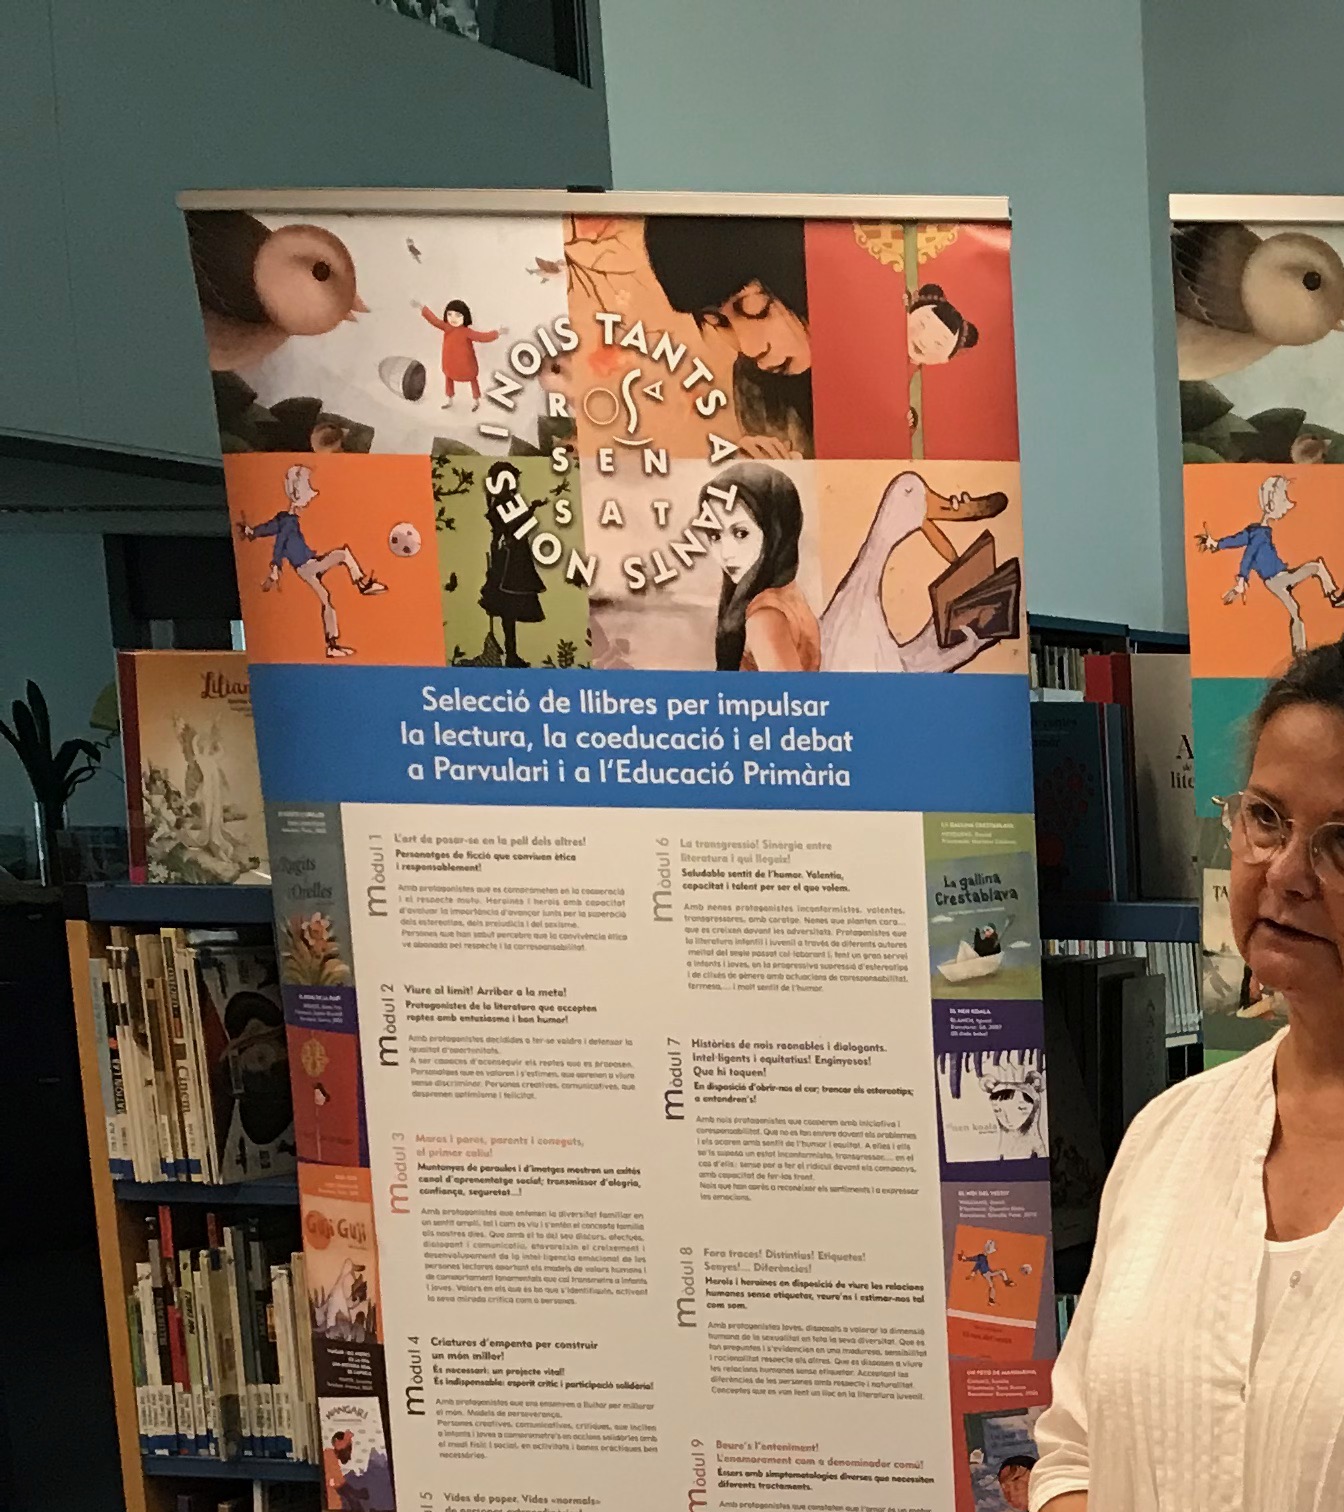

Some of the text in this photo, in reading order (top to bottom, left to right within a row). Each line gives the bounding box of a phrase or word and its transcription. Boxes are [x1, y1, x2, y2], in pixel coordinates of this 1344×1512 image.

[486, 317, 579, 409] NOIS
[595, 312, 727, 416] TANTS
[708, 433, 739, 463] A
[485, 470, 598, 586] NOIES
[624, 484, 738, 589] TANTS
[422, 686, 829, 720] Selecció de llibres per impulsar
[401, 720, 853, 751] la lectura, la coeducació i el debat
[408, 755, 850, 786] a Parvulari i a l'Educació Primària
[935, 888, 1018, 906] Crestablava
[943, 873, 1001, 890] La gallina
[338, 1218, 367, 1243] Guji
